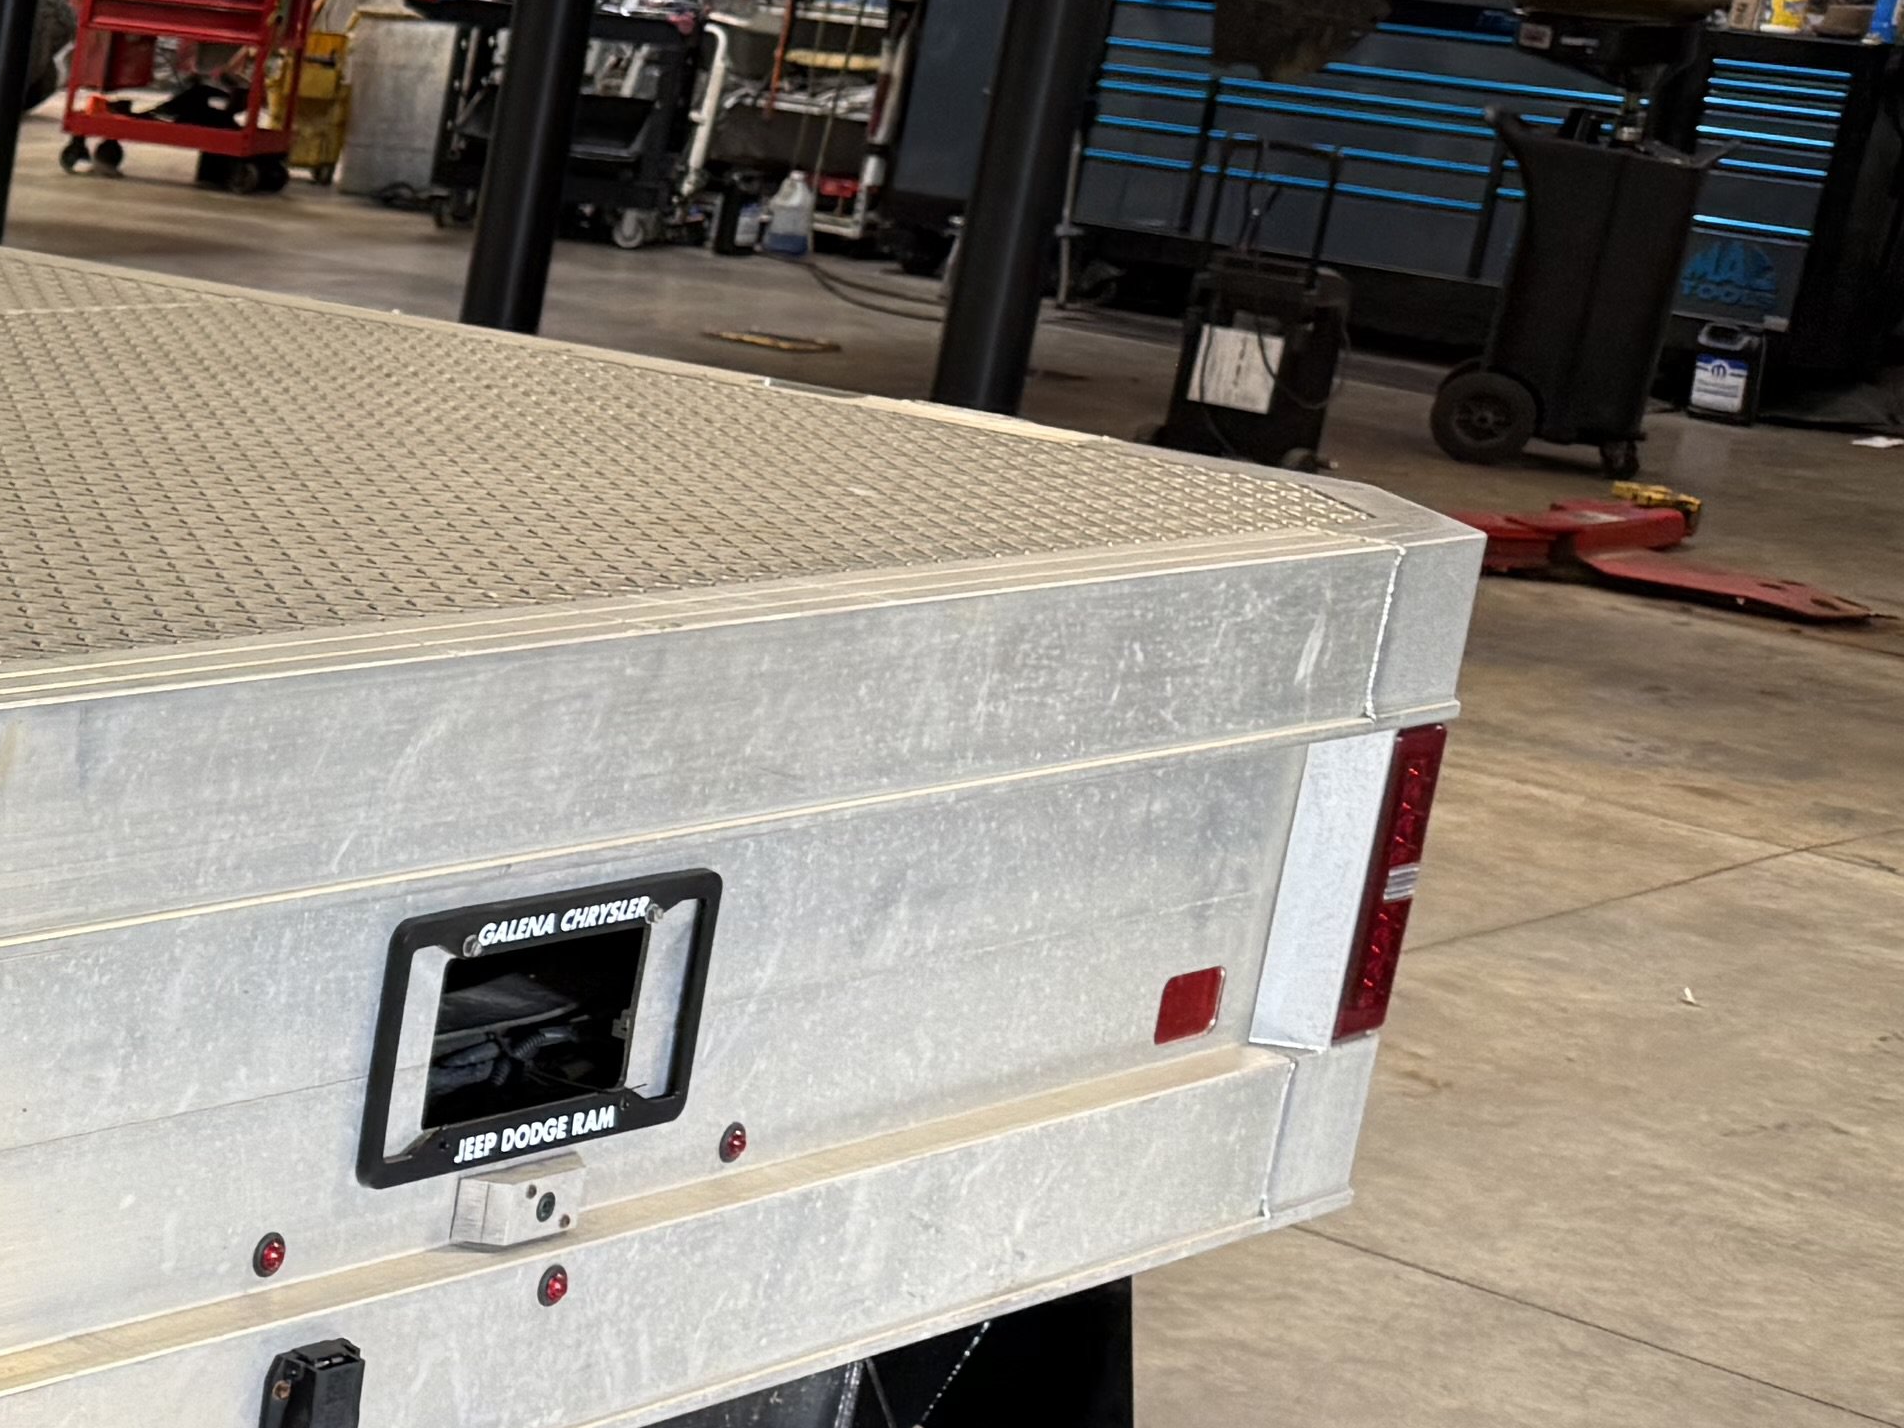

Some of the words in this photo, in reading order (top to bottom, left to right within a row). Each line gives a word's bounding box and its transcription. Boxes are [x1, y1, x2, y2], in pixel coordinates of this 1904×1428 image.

[478, 913, 557, 947] GALENA
[560, 895, 651, 933] CHRYSLER
[453, 1132, 498, 1164] JEEP
[500, 1115, 569, 1153] DODGE
[571, 1104, 616, 1137] RAM
